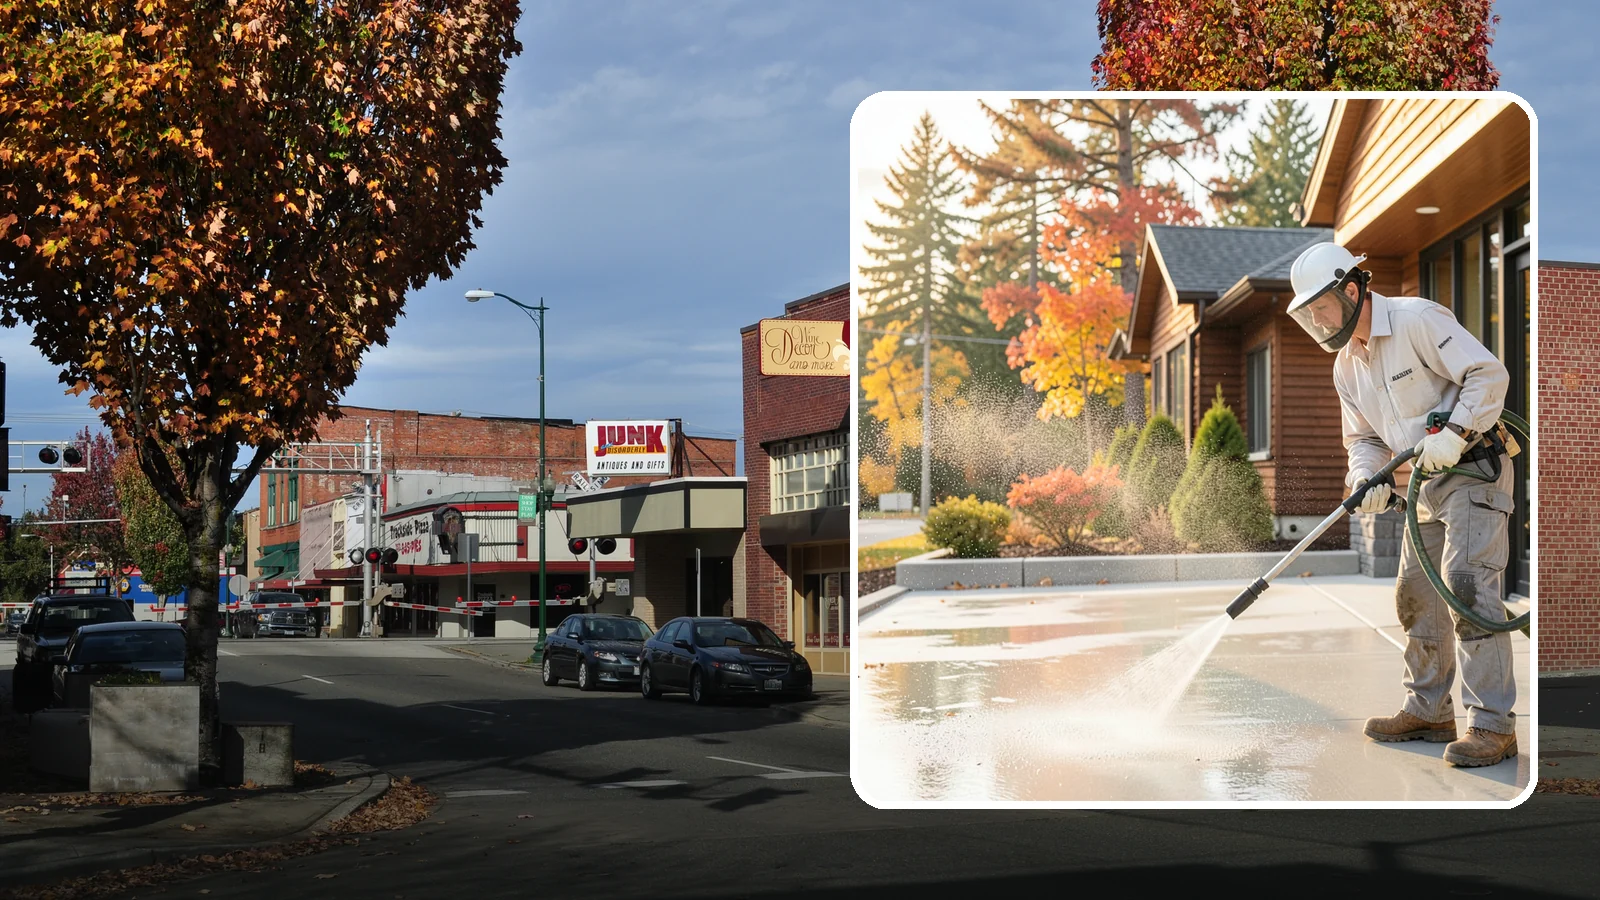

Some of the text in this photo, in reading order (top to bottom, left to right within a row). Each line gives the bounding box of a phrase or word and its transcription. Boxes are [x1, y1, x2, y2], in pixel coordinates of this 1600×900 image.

[595, 425, 665, 457] JUNK
[607, 446, 646, 454] DISORDERLY
[597, 460, 665, 469] ANTIQUES AND GIFTS
[390, 519, 429, 540] Trackside Pizza
